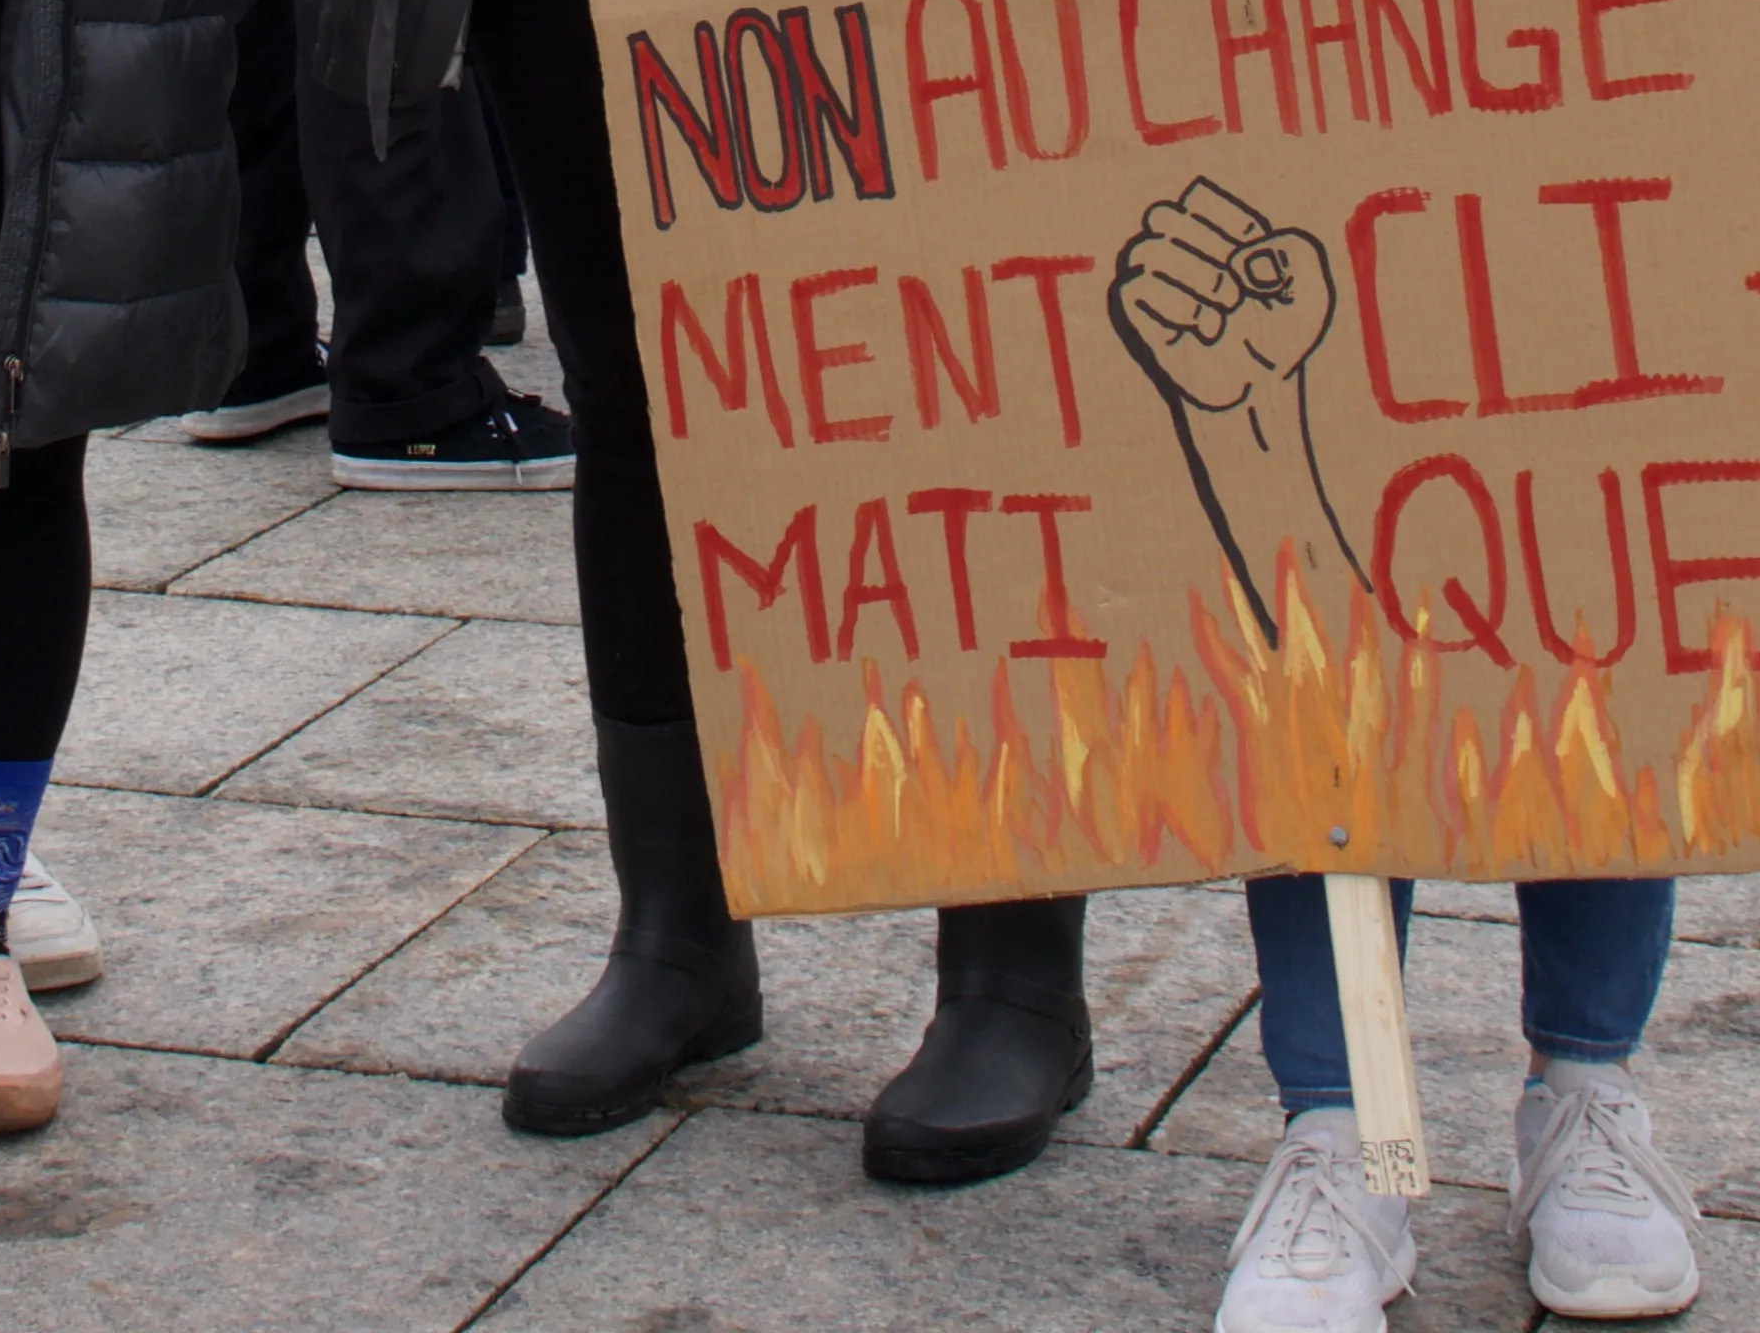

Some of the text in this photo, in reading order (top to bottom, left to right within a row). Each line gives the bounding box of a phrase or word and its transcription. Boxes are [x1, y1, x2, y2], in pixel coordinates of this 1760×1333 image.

[627, 1, 897, 231] NON
[657, 252, 1096, 450] MENT
[693, 486, 1108, 671] MATI
